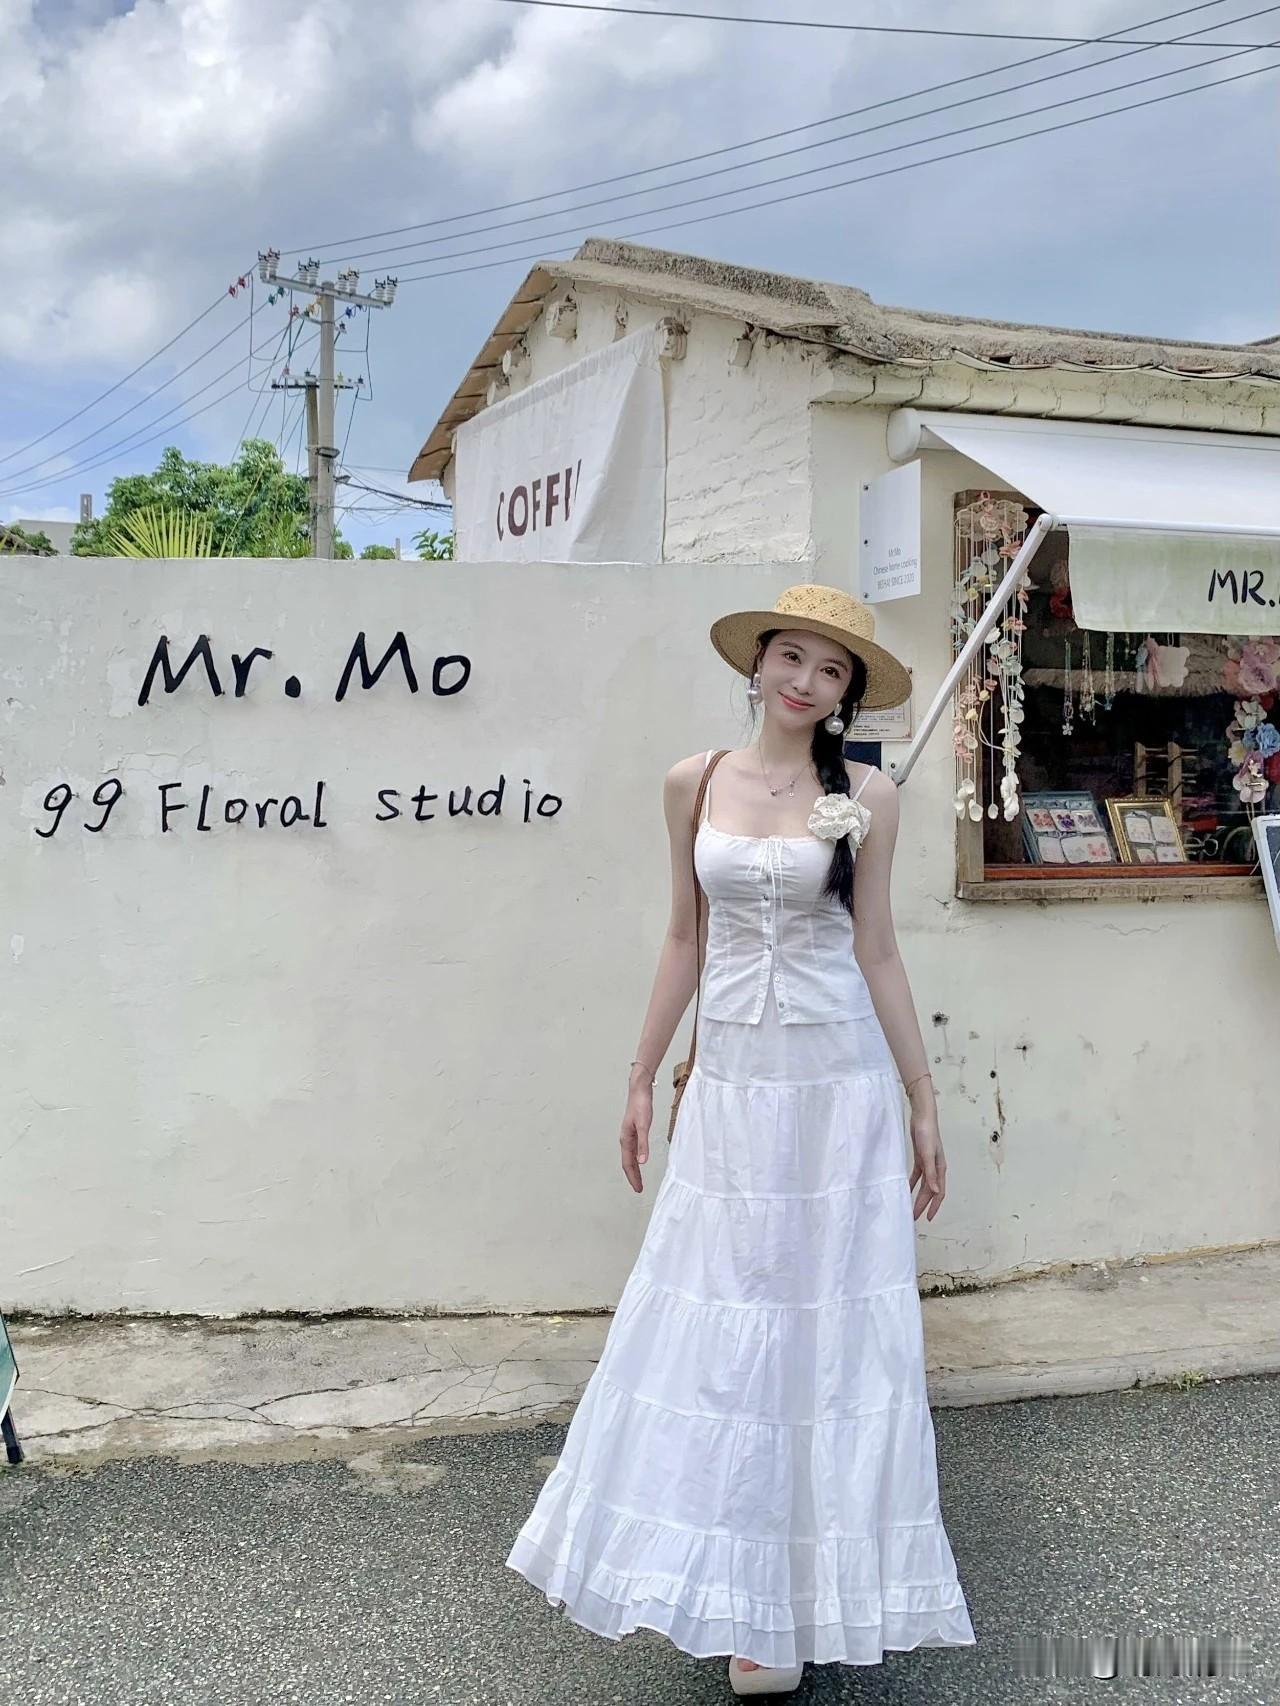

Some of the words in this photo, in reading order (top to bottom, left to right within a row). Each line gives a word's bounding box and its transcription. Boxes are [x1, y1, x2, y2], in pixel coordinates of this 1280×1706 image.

[497, 459, 582, 541] COFF
[873, 564, 889, 575] Chinese
[1207, 568, 1280, 608] MR.
[137, 634, 302, 706] Mr.
[335, 631, 472, 702] Mo
[158, 780, 328, 832] Floral
[376, 774, 563, 823] studio
